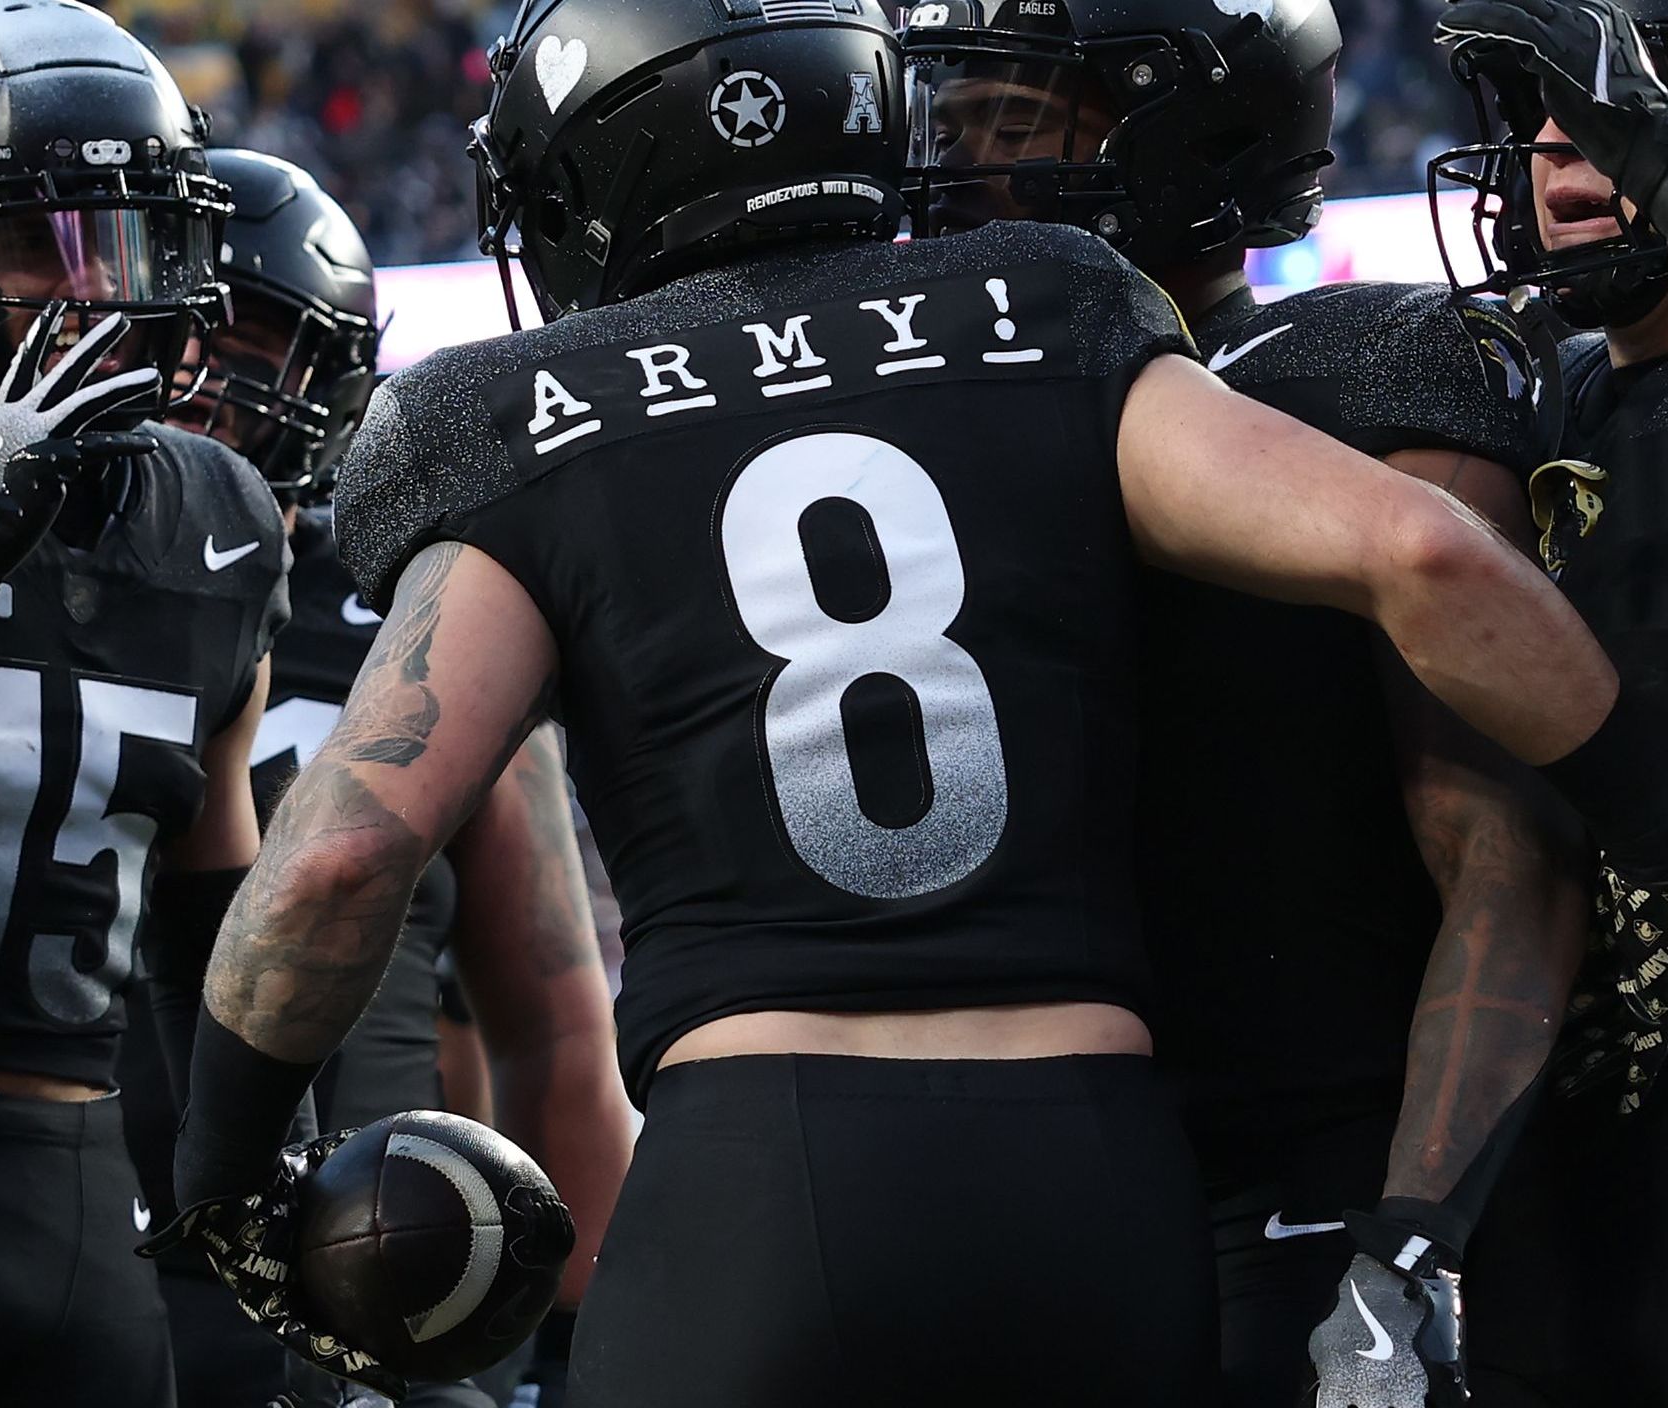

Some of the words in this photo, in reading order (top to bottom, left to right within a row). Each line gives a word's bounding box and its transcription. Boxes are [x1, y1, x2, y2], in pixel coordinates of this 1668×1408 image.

[1018, 1, 1056, 15] EAGLES
[746, 182, 819, 213] RENDEZVOUS
[821, 181, 850, 194] WITH
[527, 277, 1044, 455] ARMY!
[721, 431, 1008, 900] 8
[239, 1252, 289, 1283] ARMY
